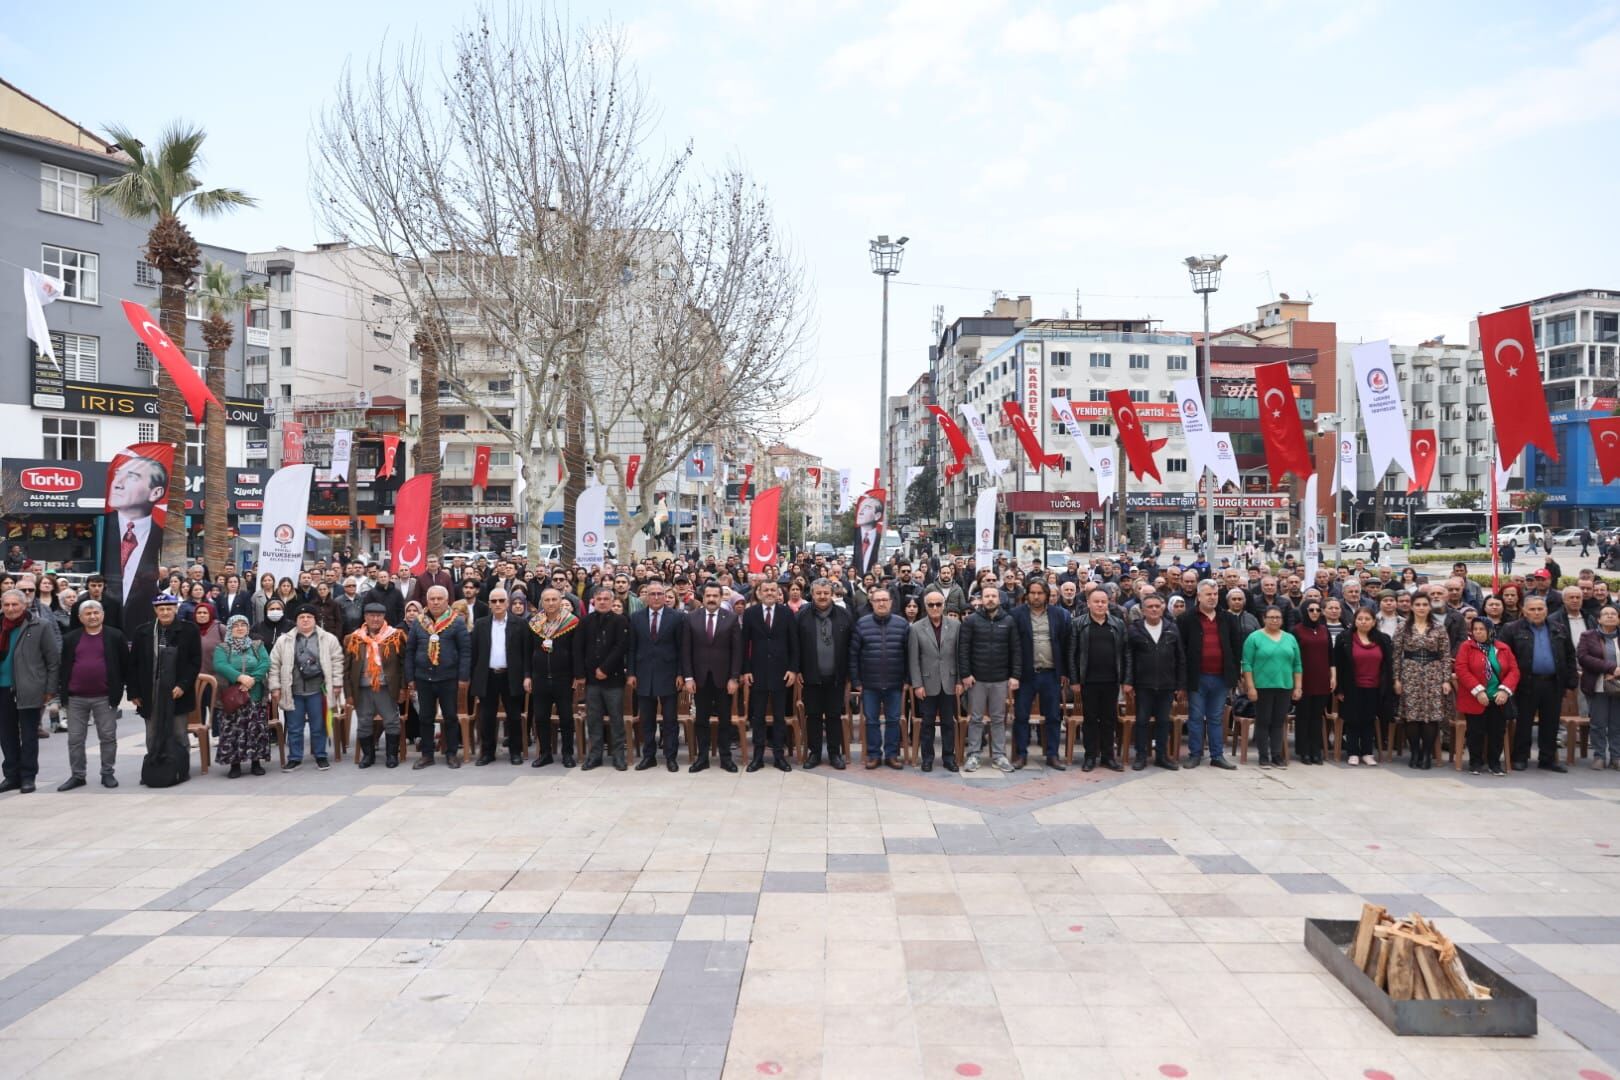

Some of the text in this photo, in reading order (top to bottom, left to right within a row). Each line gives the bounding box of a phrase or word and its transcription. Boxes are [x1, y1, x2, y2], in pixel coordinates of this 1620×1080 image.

[225, 410, 258, 422] LONU
[27, 472, 75, 486] Torku
[1251, 498, 1274, 506] KING
